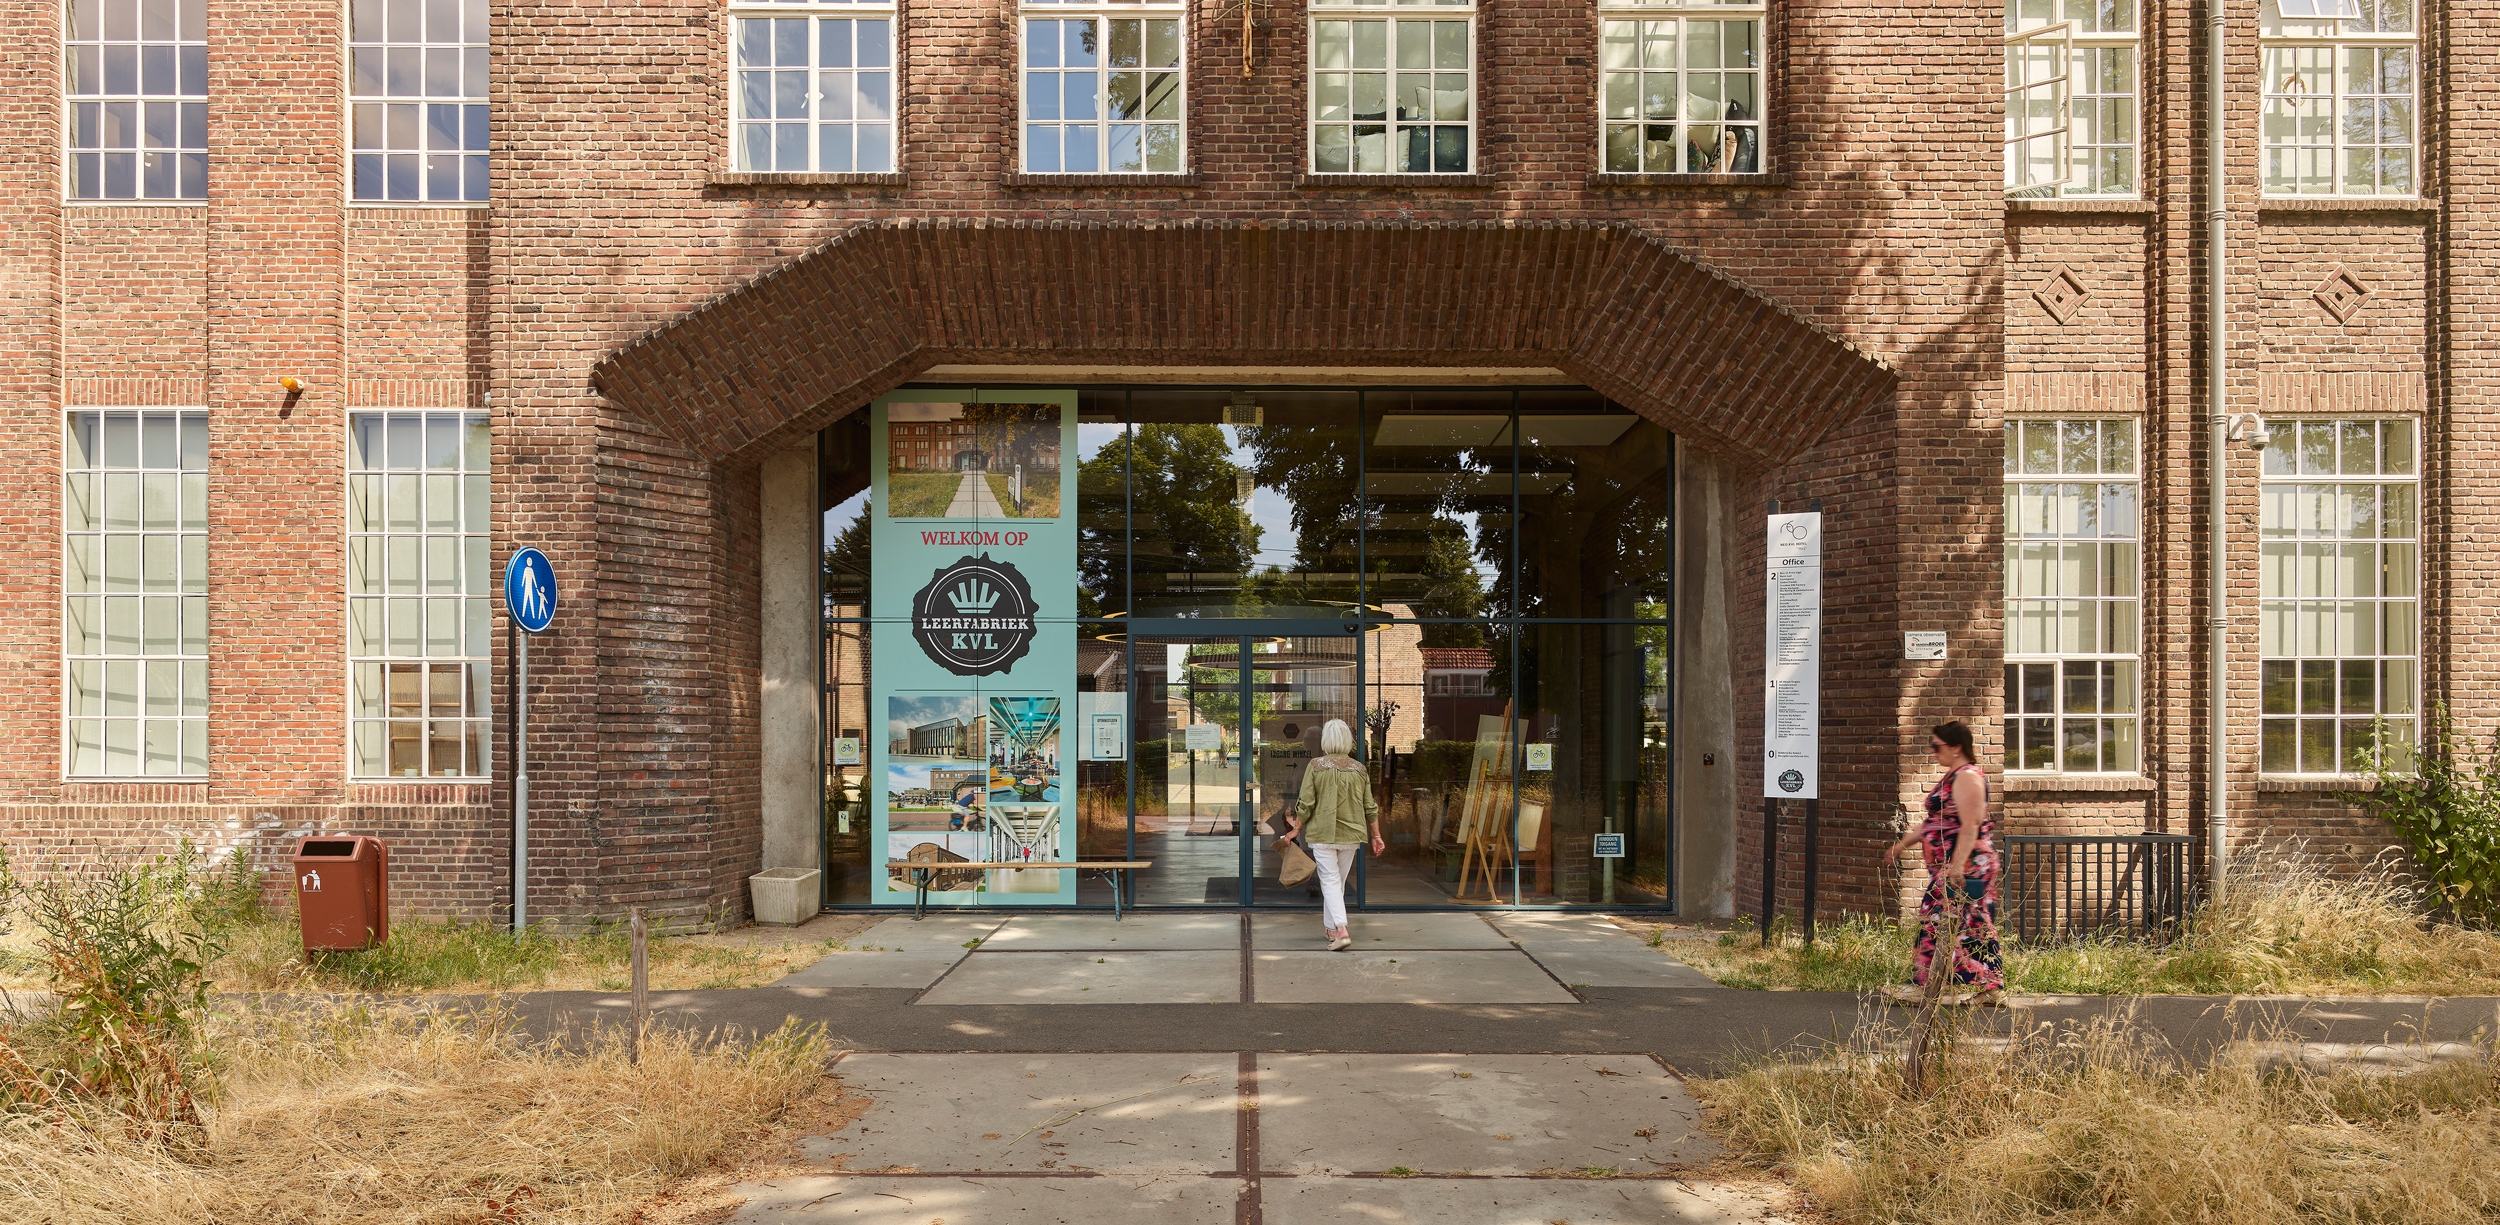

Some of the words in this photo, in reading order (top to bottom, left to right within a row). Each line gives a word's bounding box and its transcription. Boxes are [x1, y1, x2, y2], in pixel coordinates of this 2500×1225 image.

[920, 531, 1000, 546] WELKOM
[1004, 531, 1029, 546] OP
[1782, 558, 1805, 566] Office
[1771, 572, 1777, 580] 2
[921, 617, 1029, 630] LEERFABRIEK
[951, 632, 998, 650] KVL
[1770, 680, 1775, 688] 1
[1292, 750, 1312, 759] WINKEL
[1768, 750, 1775, 758] 0
